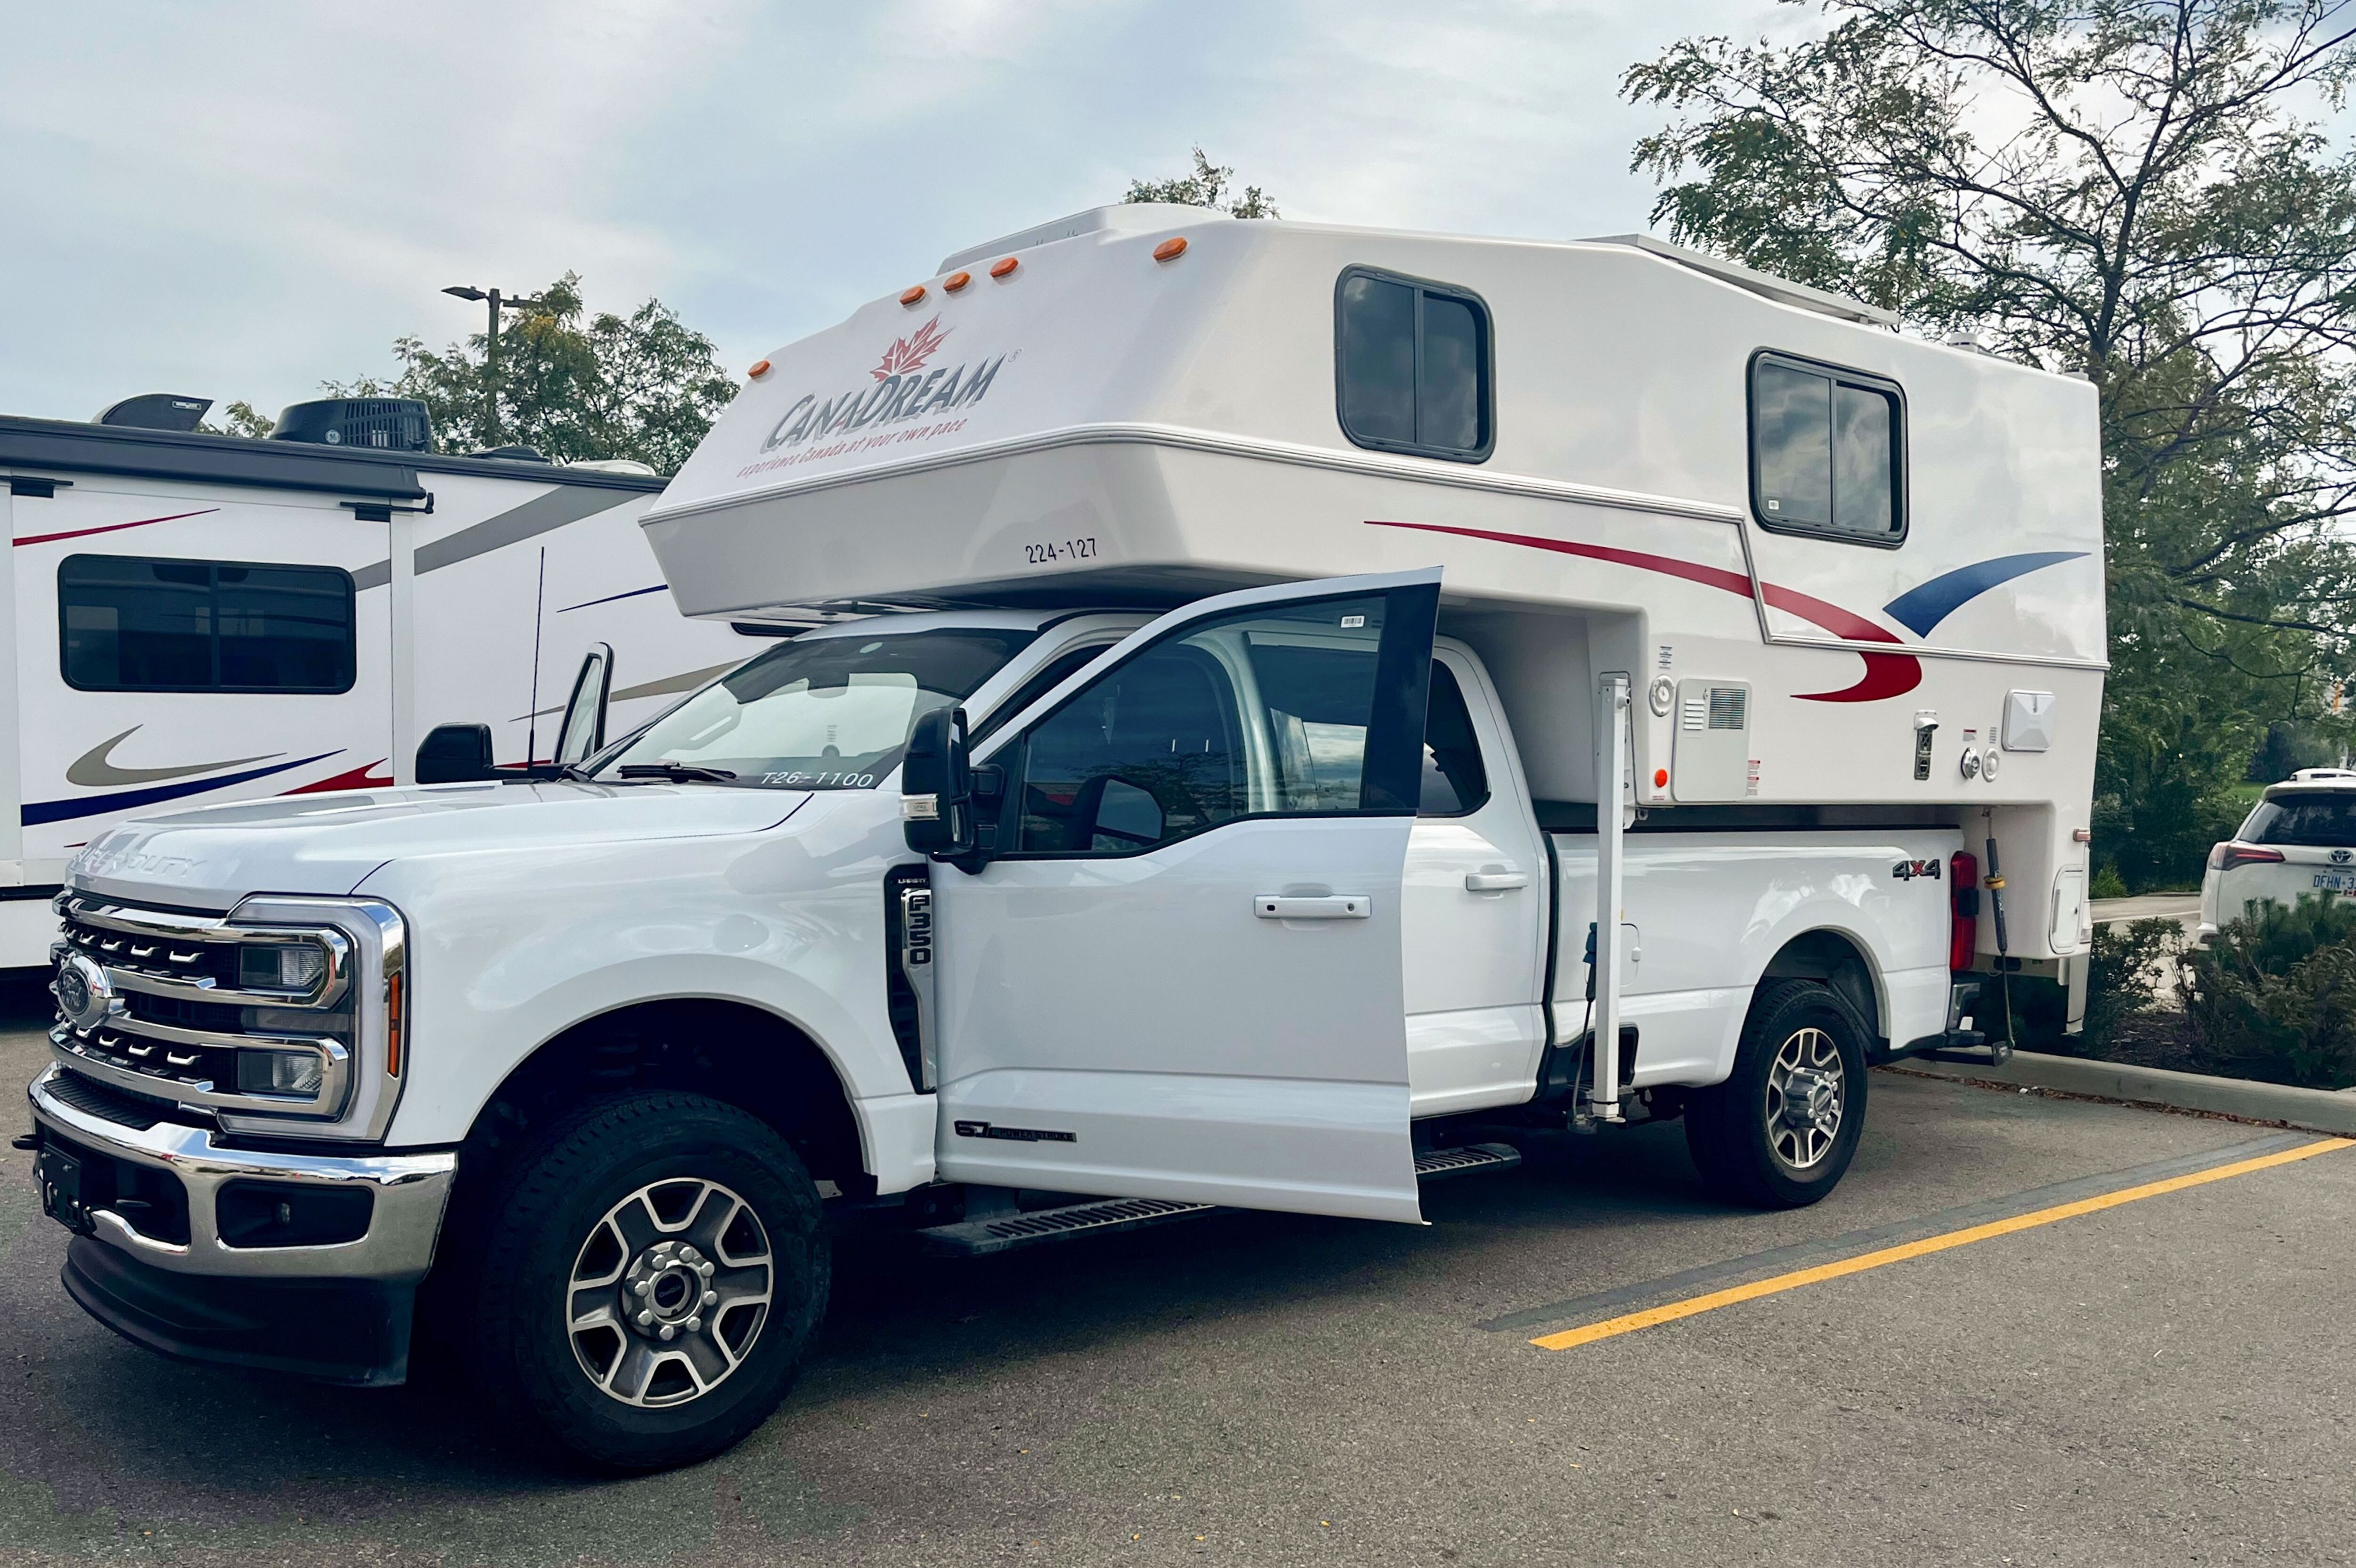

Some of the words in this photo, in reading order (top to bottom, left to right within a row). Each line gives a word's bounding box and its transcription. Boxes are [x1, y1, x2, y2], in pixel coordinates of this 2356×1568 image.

[736, 453, 801, 479] experience
[798, 441, 847, 464] Canada
[844, 436, 867, 454] at
[860, 431, 900, 453] your
[896, 426, 931, 443] own
[925, 418, 968, 441] pace
[1025, 538, 1096, 564] 224-127
[761, 771, 874, 788] T26-1100
[908, 894, 932, 965] F350
